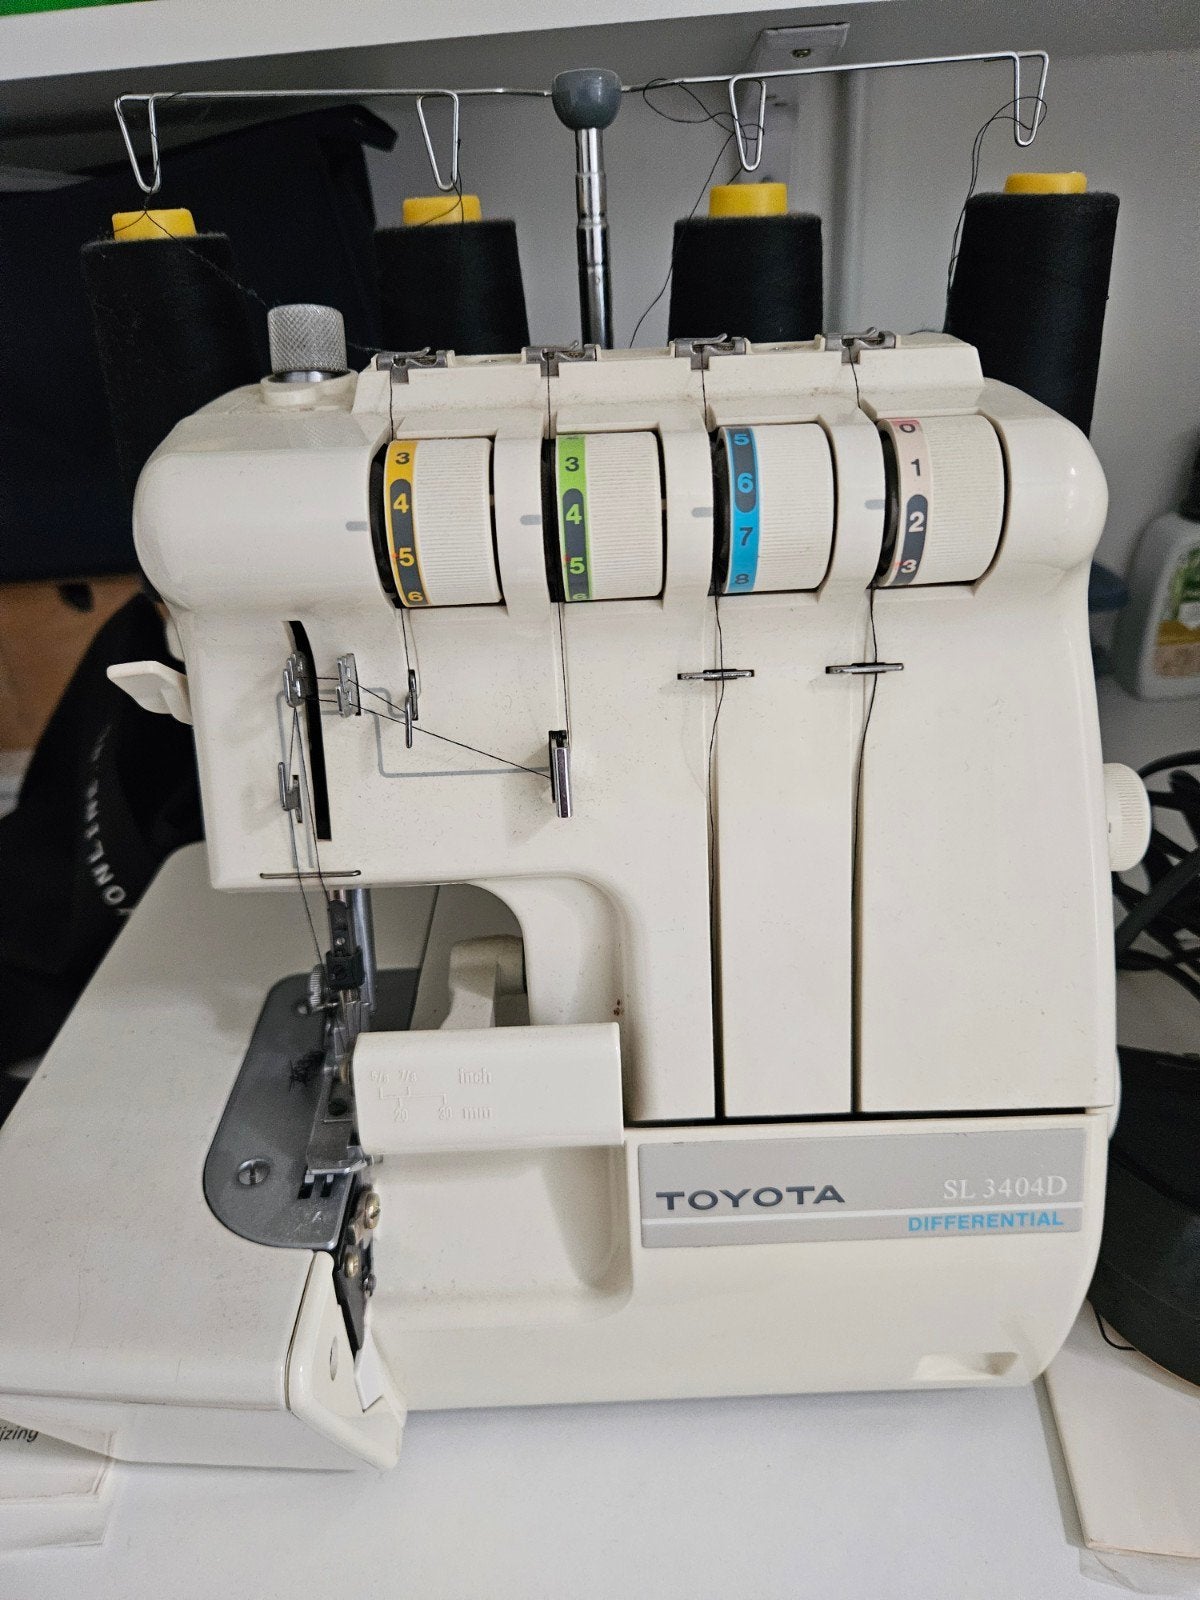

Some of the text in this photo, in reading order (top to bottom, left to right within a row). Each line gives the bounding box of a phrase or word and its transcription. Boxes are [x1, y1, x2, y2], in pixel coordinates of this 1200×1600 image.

[734, 434, 749, 446] 5
[395, 452, 410, 465] 3
[565, 456, 580, 472] 3
[910, 458, 921, 476] 1
[737, 473, 754, 493] 6
[393, 493, 409, 513] 4
[566, 504, 582, 524] 4
[909, 511, 924, 532] 2
[739, 527, 753, 546] 7
[399, 547, 414, 567] 5
[570, 557, 585, 574] 5
[900, 559, 917, 573] 3
[734, 574, 749, 585] 8
[408, 591, 423, 602] 6
[458, 1067, 492, 1085] inch
[943, 1175, 1068, 1199] SL 3404D
[655, 1184, 845, 1211] TOYOTA
[908, 1211, 1064, 1232] DIFFERENTIAL
